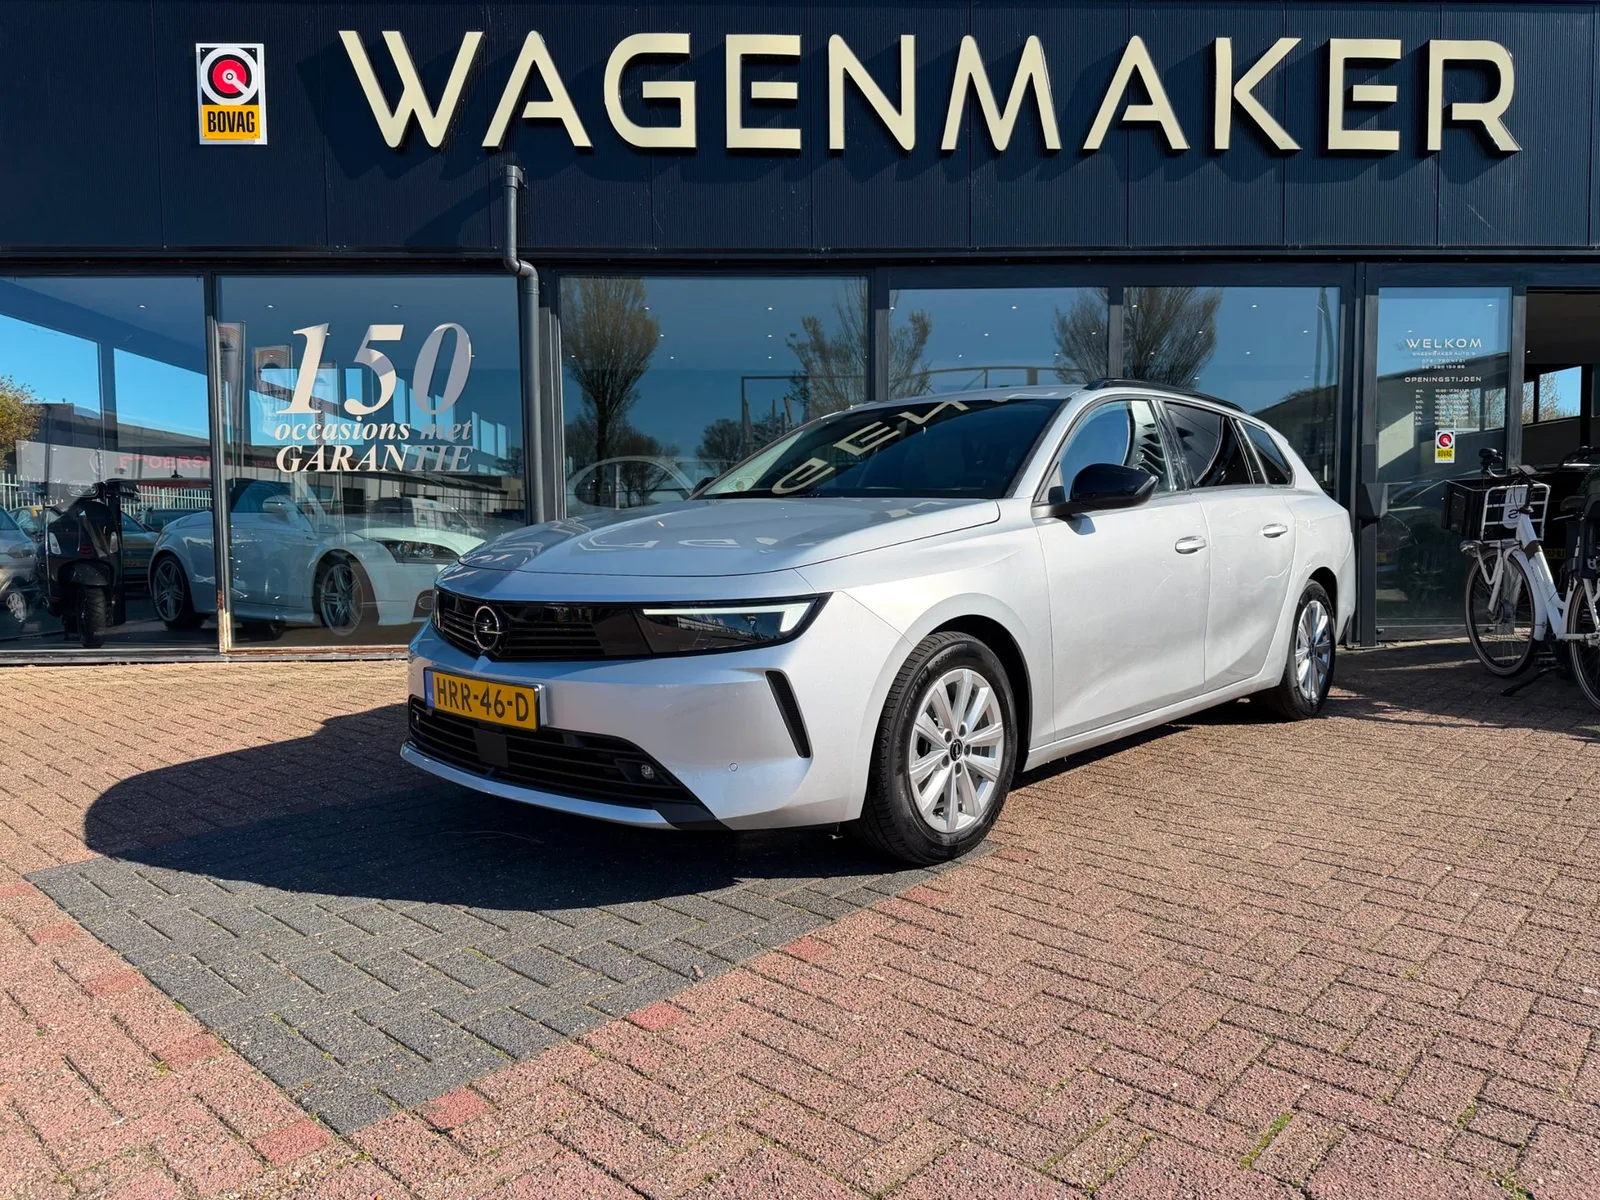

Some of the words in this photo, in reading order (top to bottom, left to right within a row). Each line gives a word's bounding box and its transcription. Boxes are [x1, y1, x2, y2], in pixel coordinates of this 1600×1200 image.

[338, 30, 1523, 153] WAGENMAKER
[207, 111, 255, 133] BOVAG
[1406, 338, 1482, 349] WELKOM
[276, 323, 472, 415] 150
[274, 416, 411, 441] occasions
[419, 420, 472, 441] met
[276, 444, 474, 473] GARANTIE
[1437, 449, 1453, 457] BOVAG
[436, 677, 529, 722] HRR-46-D
